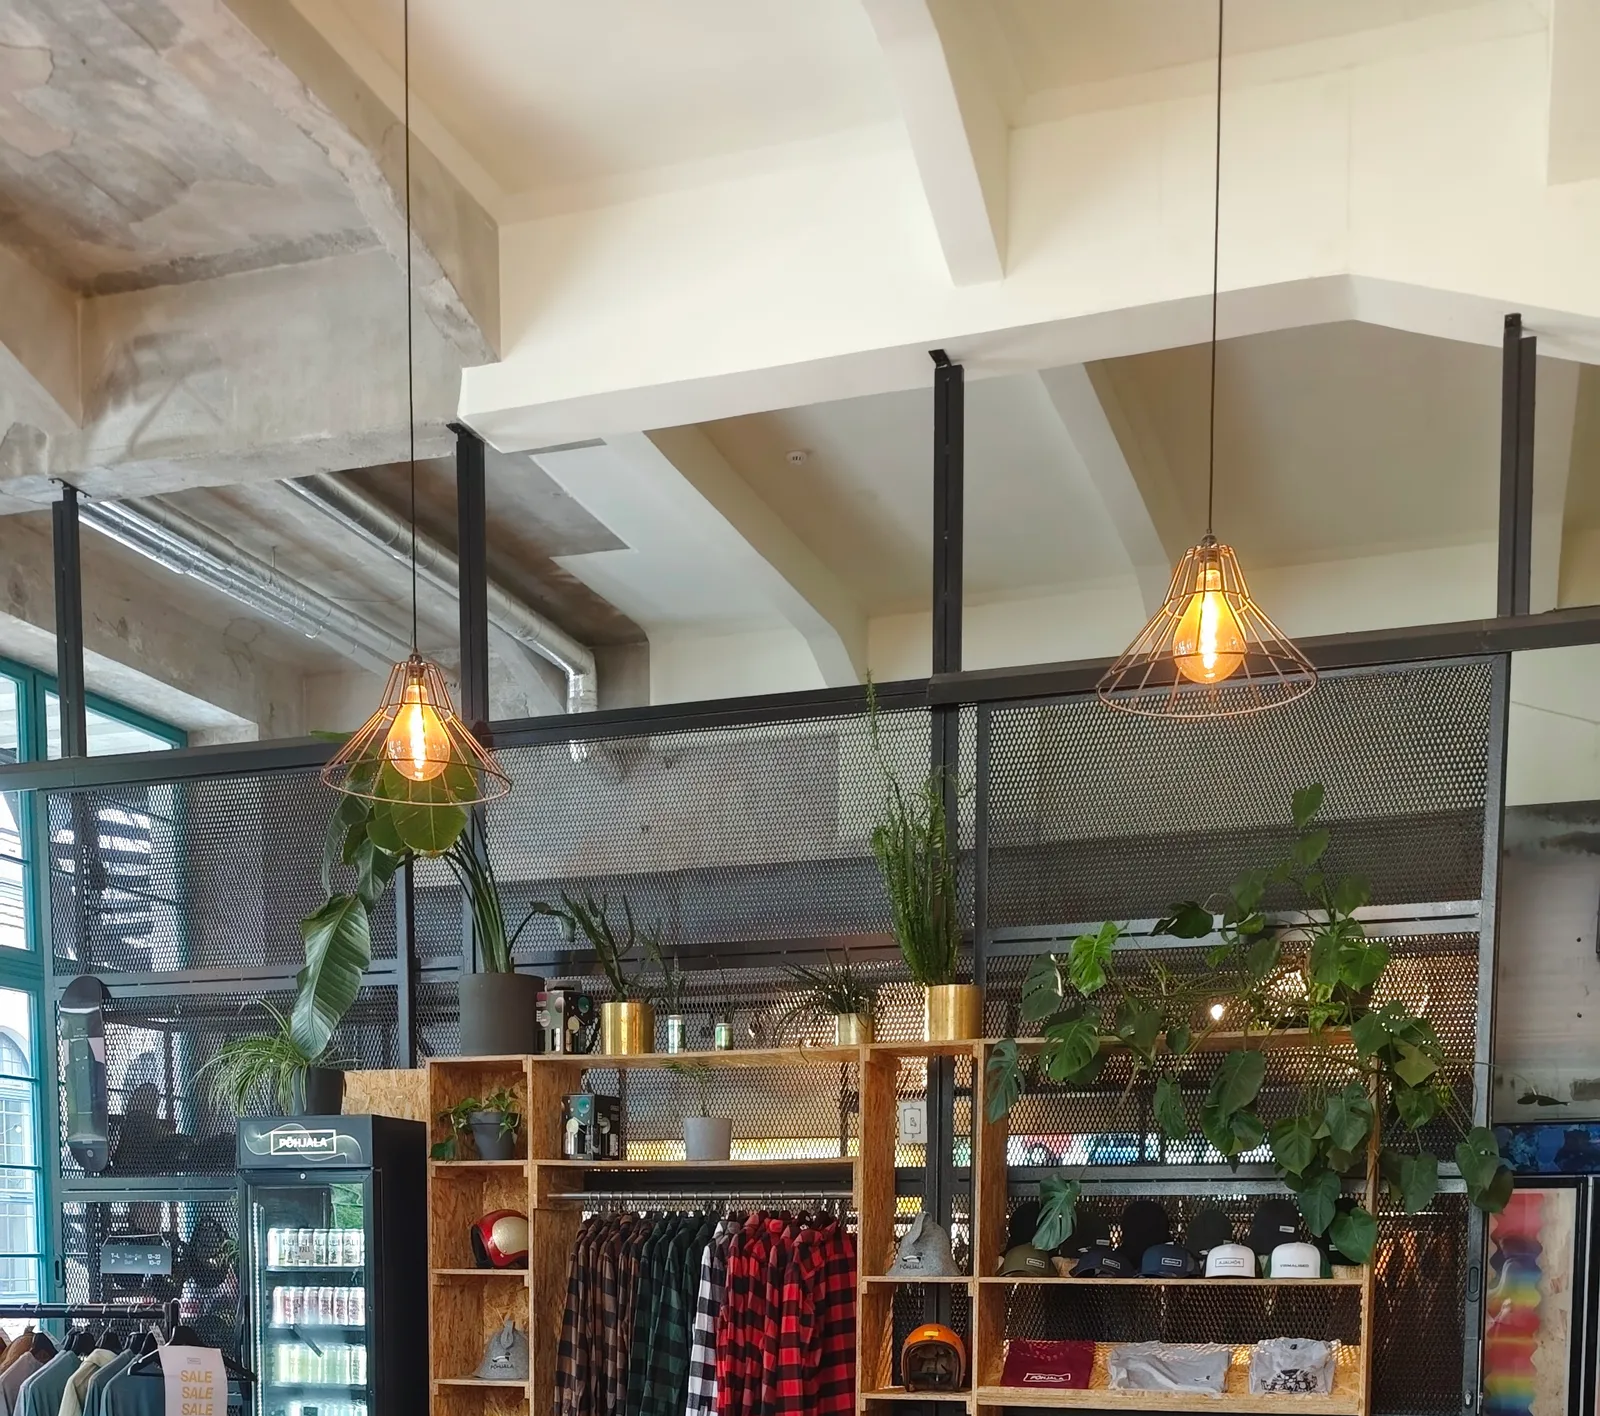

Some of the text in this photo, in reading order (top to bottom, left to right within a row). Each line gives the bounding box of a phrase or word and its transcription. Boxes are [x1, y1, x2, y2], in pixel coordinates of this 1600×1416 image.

[180, 1370, 212, 1383] SALE
[181, 1387, 213, 1399] SALE
[181, 1403, 213, 1416] SALE
